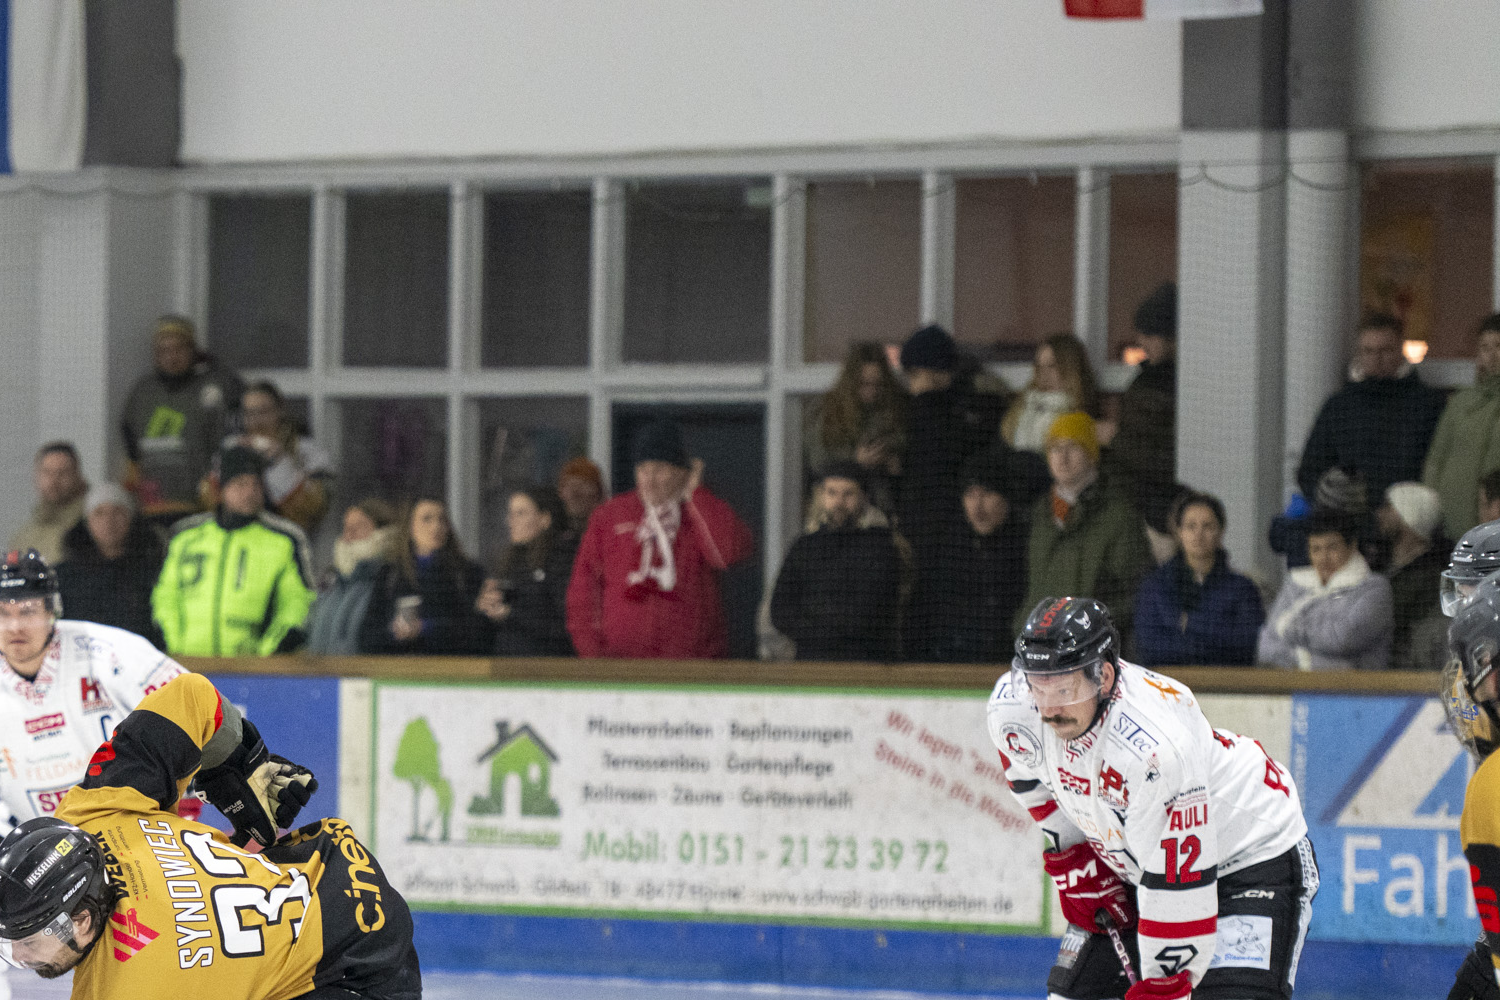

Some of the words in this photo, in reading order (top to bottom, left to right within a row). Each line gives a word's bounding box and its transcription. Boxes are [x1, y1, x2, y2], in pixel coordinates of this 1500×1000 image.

[1026, 653, 1050, 661] CCM
[1113, 715, 1152, 753] SiTec
[1167, 803, 1208, 831] AULI
[26, 850, 62, 886] HESSELINK
[58, 842, 71, 854] 24
[580, 830, 667, 865] Mobil:
[677, 831, 745, 867] 0151
[779, 836, 810, 868] 21
[822, 837, 859, 870] 23
[868, 838, 902, 872] 39
[916, 839, 950, 874] 72
[1161, 835, 1201, 883] 12
[137, 818, 214, 969] SYNOWIEC
[1342, 833, 1478, 919] Fah
